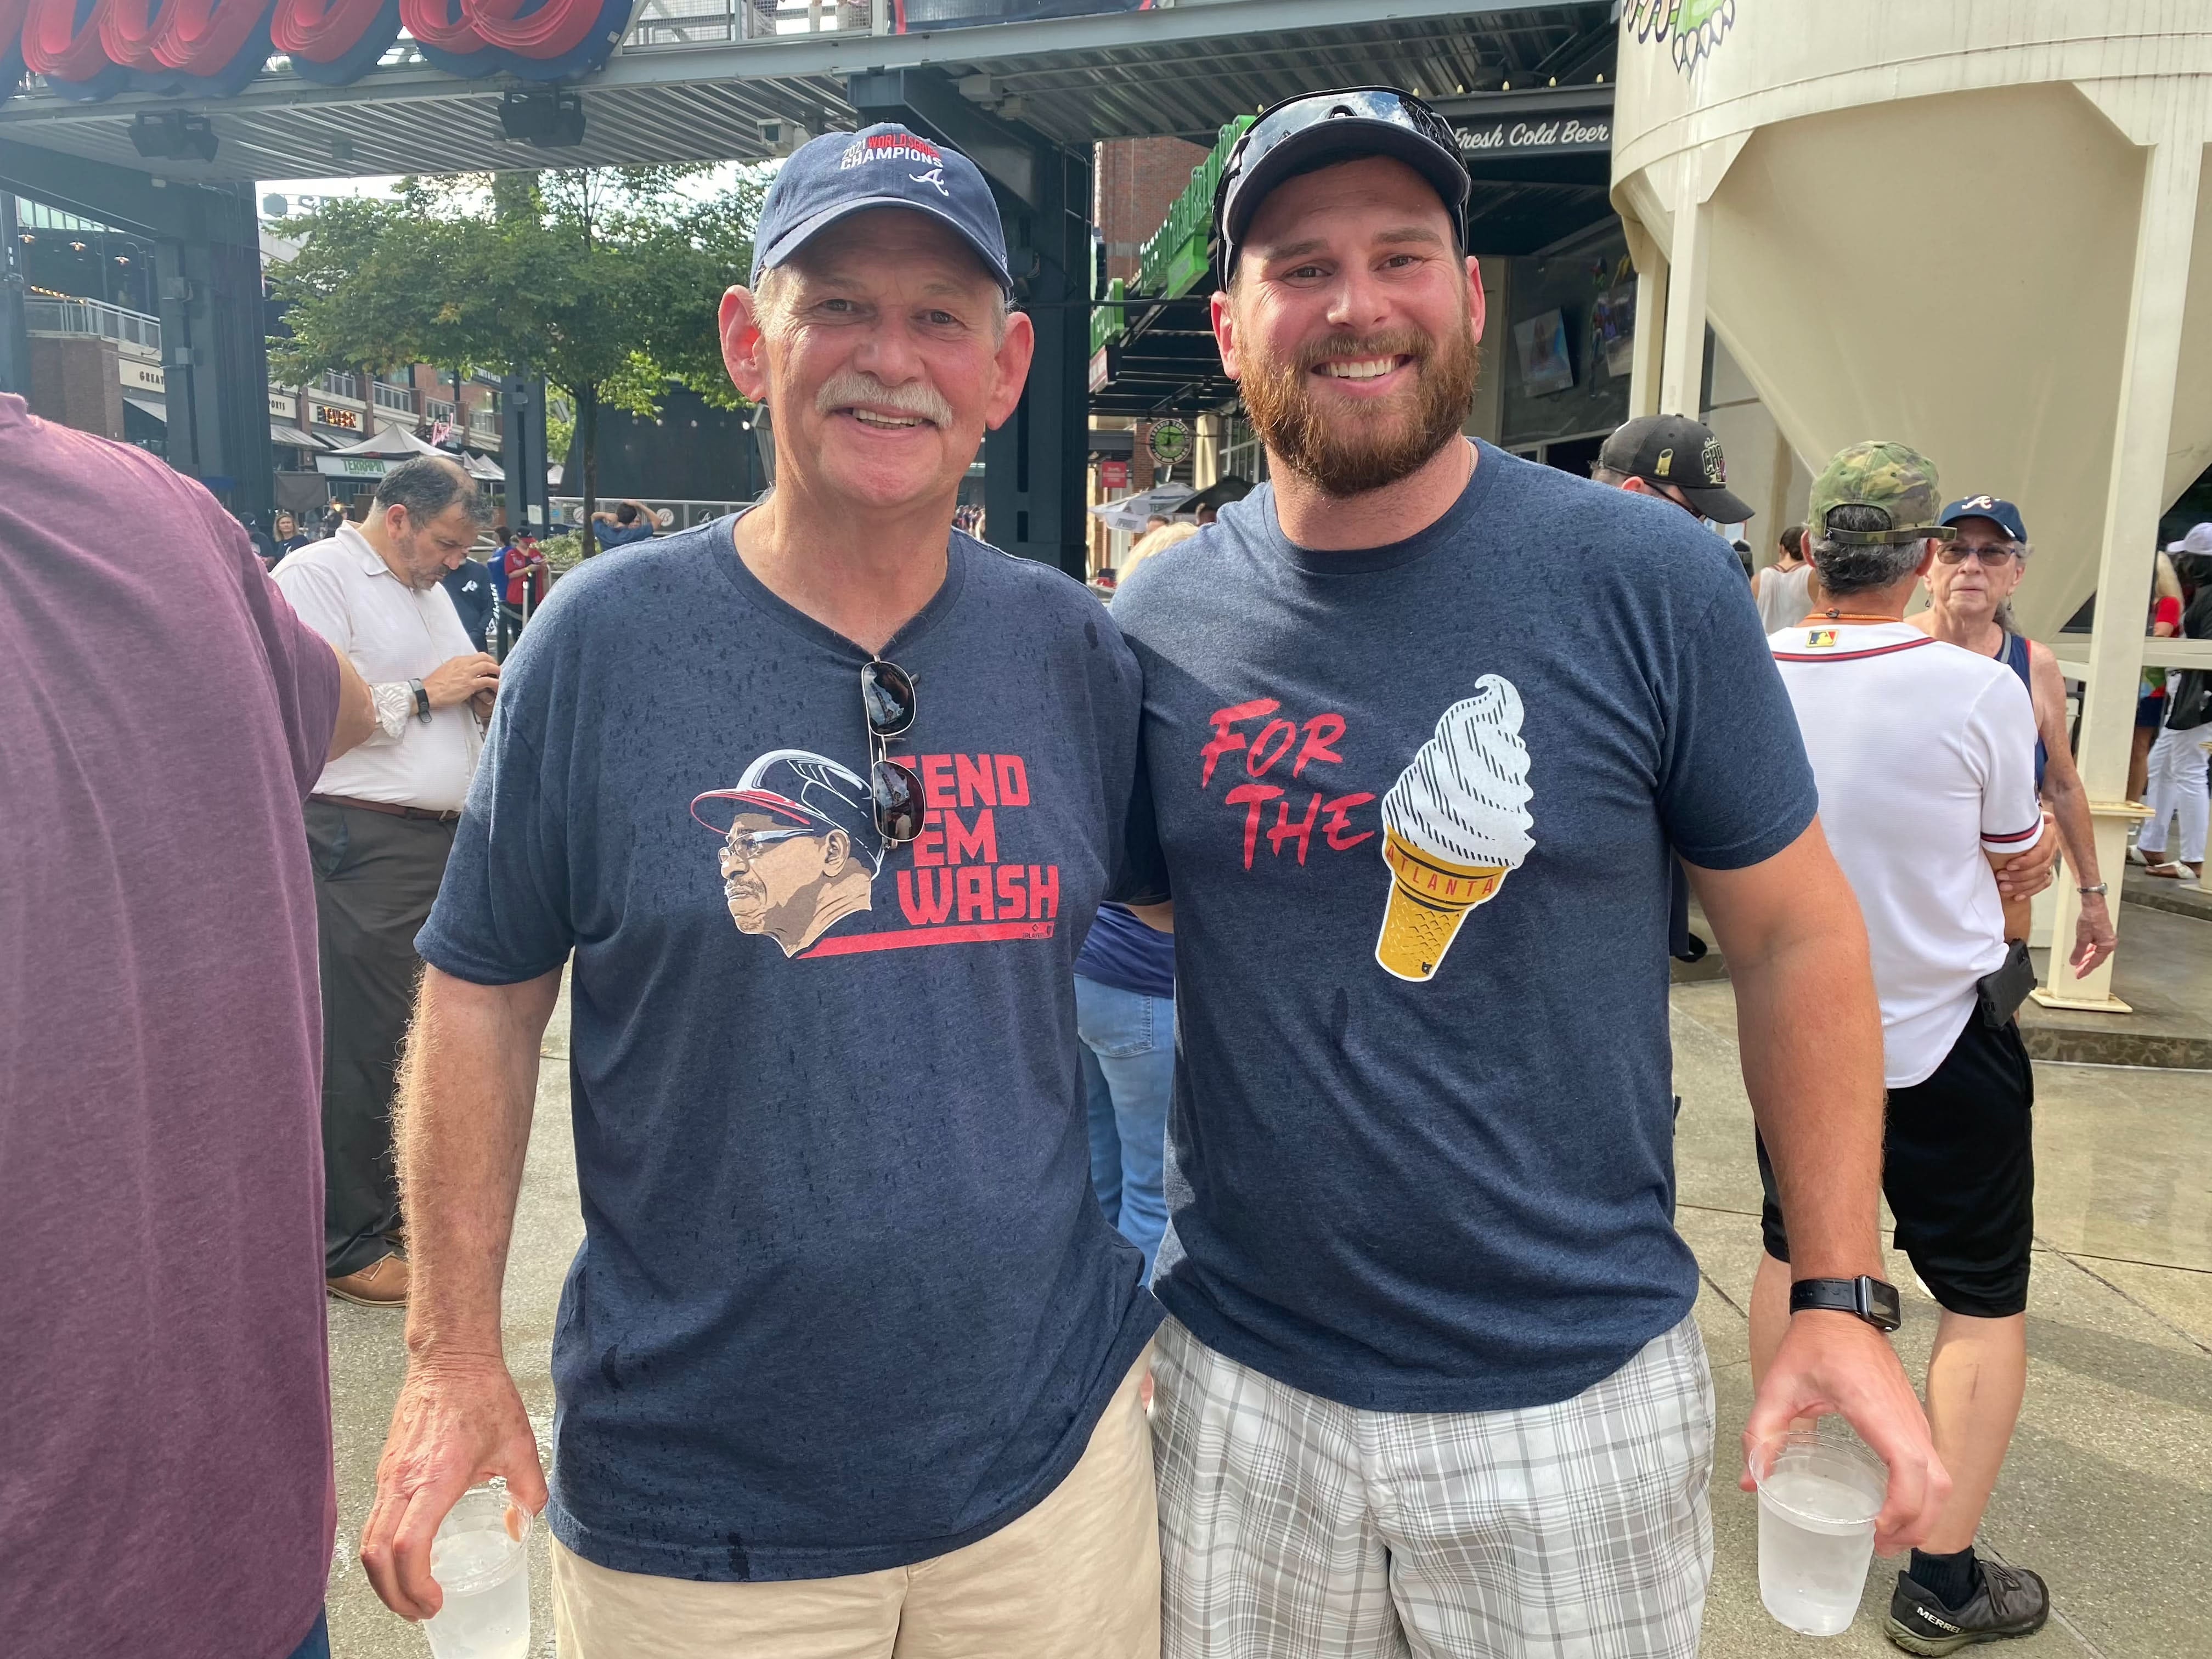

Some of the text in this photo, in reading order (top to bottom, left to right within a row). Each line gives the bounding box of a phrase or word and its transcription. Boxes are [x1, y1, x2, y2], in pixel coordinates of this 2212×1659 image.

[842, 133, 941, 161] 2021 WORLD SERIES
[1454, 120, 1609, 150] Fresh Cold Beer
[840, 146, 944, 170] CHAMPIONS
[139, 371, 163, 385] GREAT
[341, 458, 386, 473] TERRAPIN
[1200, 697, 1347, 789] FOR
[1225, 784, 1376, 871] THE
[1386, 845, 1494, 896] ATLANTA
[896, 865, 1059, 926] WASH
